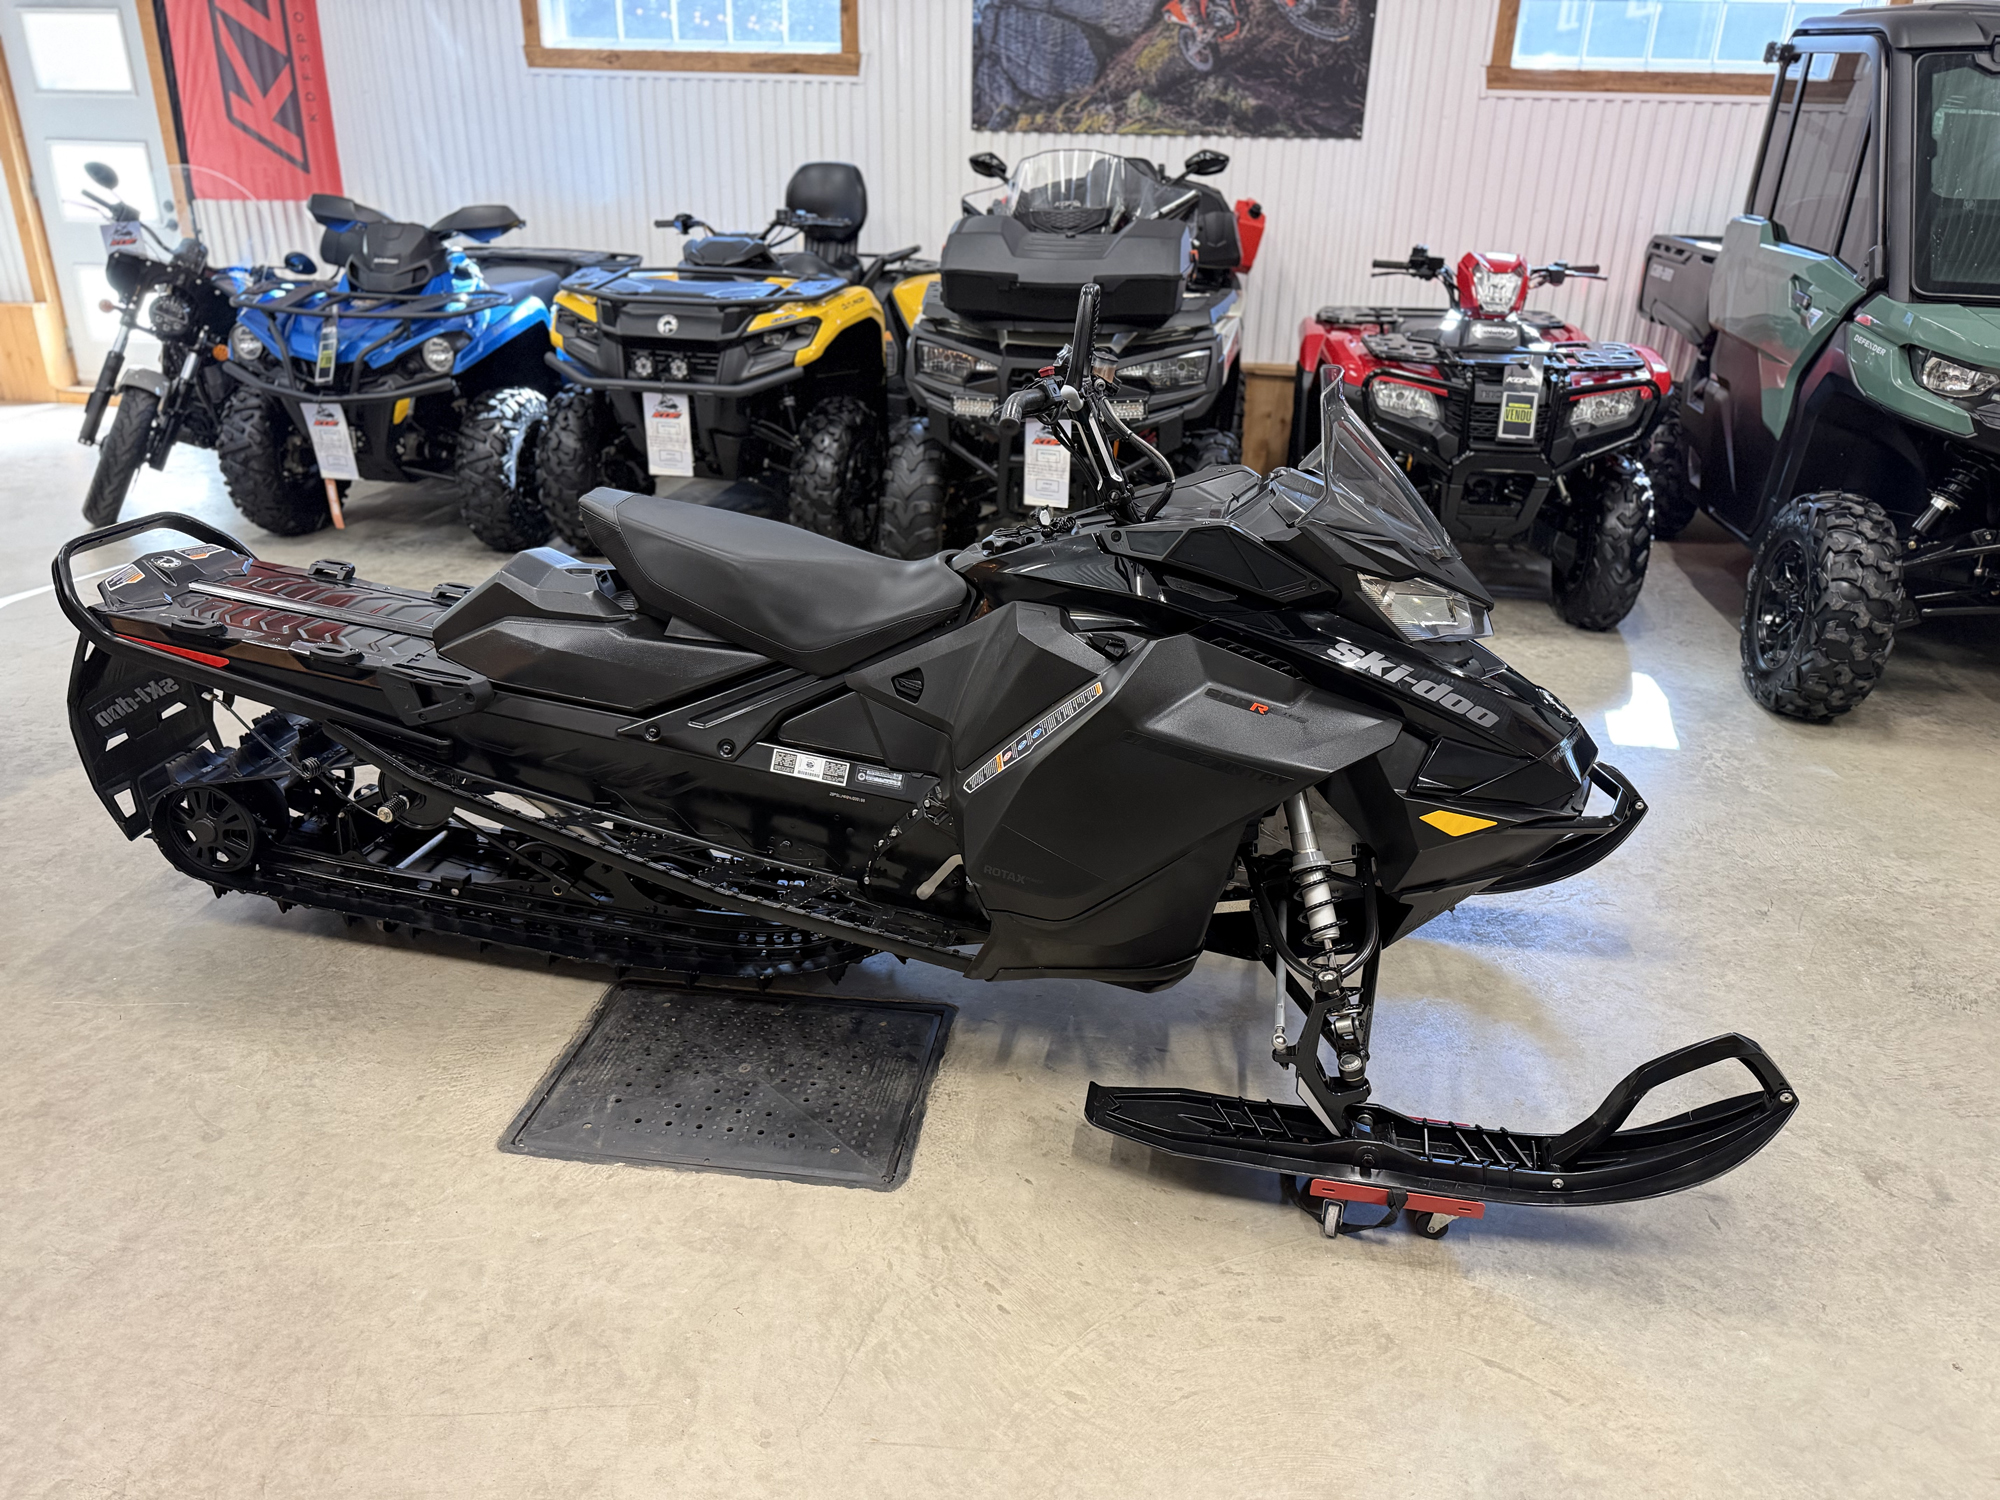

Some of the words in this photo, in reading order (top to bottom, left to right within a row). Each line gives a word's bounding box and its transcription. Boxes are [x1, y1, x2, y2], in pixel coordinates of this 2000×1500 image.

[1854, 334, 1887, 356] DEFENDER
[1504, 408, 1533, 422] VENDU
[983, 864, 1025, 885] ROTAX
